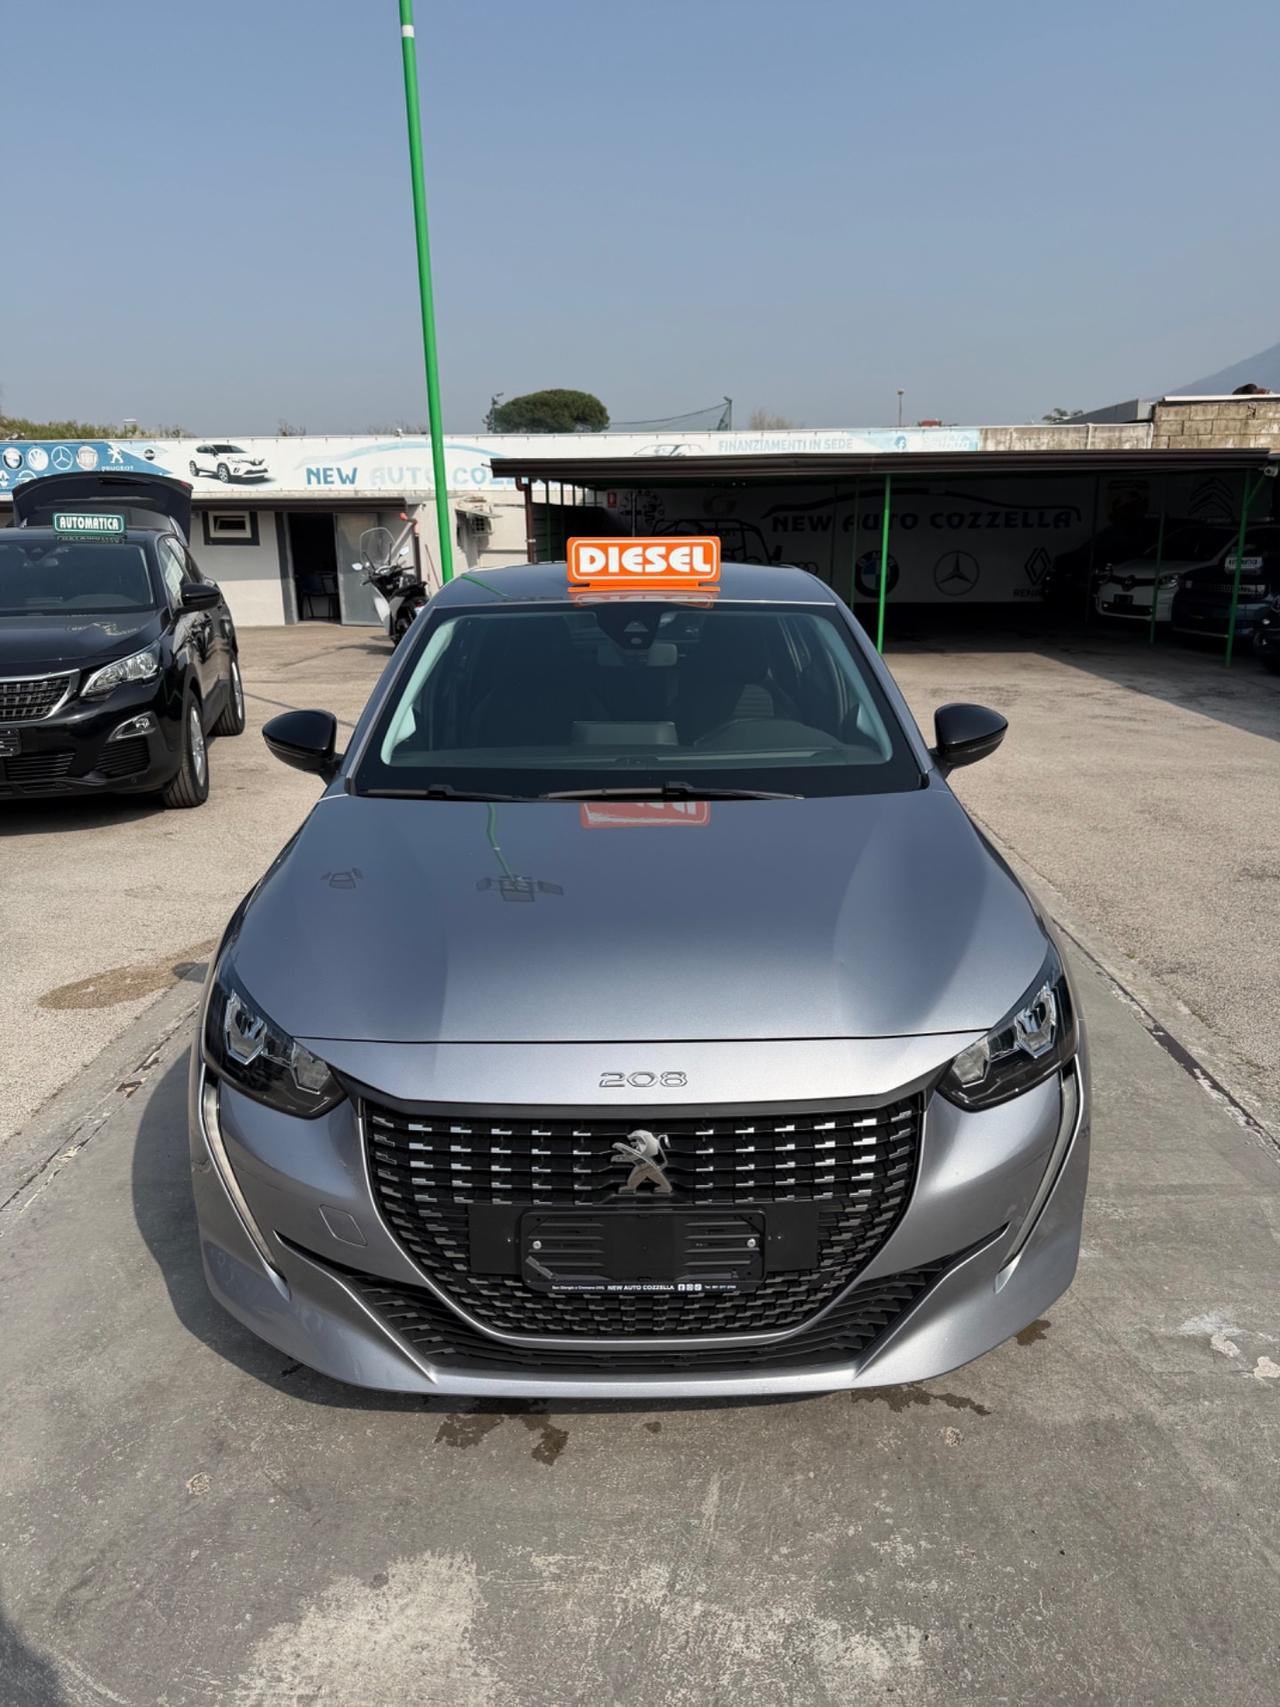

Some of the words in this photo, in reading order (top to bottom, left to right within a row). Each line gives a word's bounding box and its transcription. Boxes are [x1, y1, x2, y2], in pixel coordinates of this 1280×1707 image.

[717, 440, 807, 452] FINANZIAMENTI
[808, 439, 821, 451] IN
[824, 438, 853, 450] SEDE
[305, 467, 358, 486] NEW
[59, 516, 119, 531] AUTOMATICA
[772, 515, 833, 533] NEW
[928, 511, 1072, 530] COZZELLA
[578, 545, 712, 574] DIESEL
[598, 1071, 688, 1088] 208
